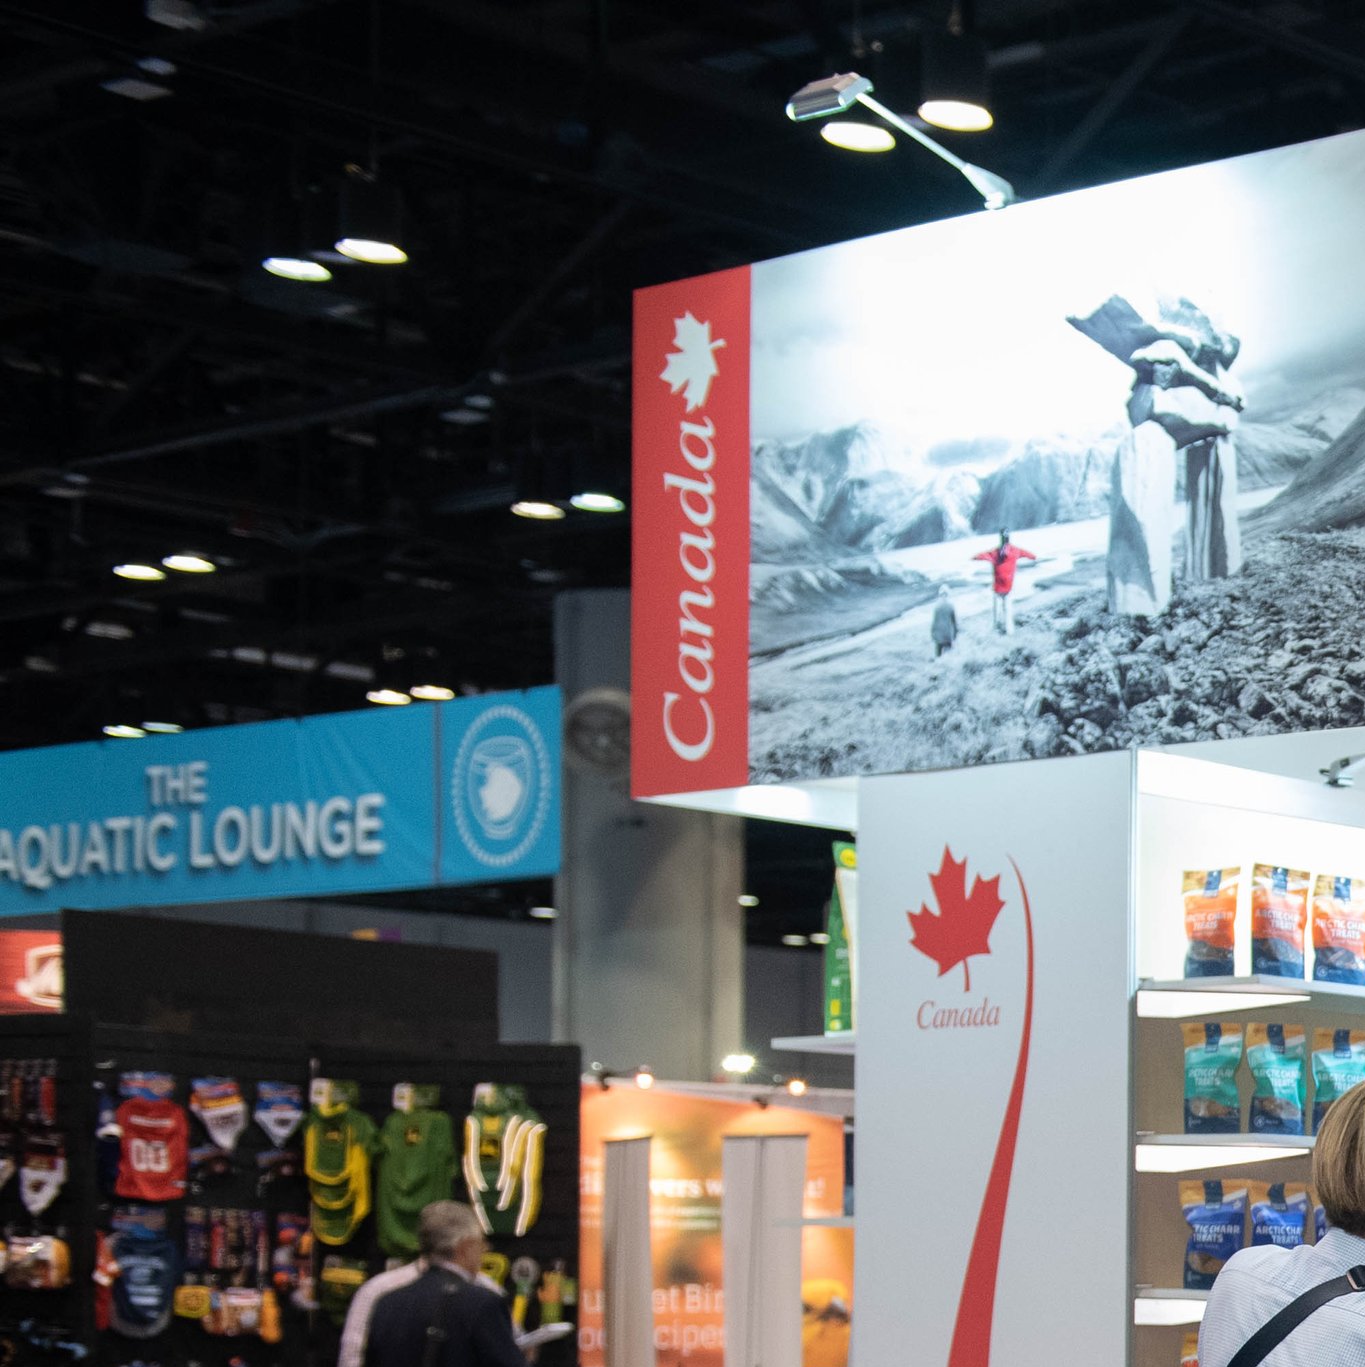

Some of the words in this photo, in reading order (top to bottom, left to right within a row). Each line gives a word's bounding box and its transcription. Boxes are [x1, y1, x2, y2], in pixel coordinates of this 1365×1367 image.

[664, 415, 719, 761] Canada
[145, 760, 209, 806] THE
[189, 792, 387, 869] LOUNGE
[915, 996, 1002, 1030] Canada
